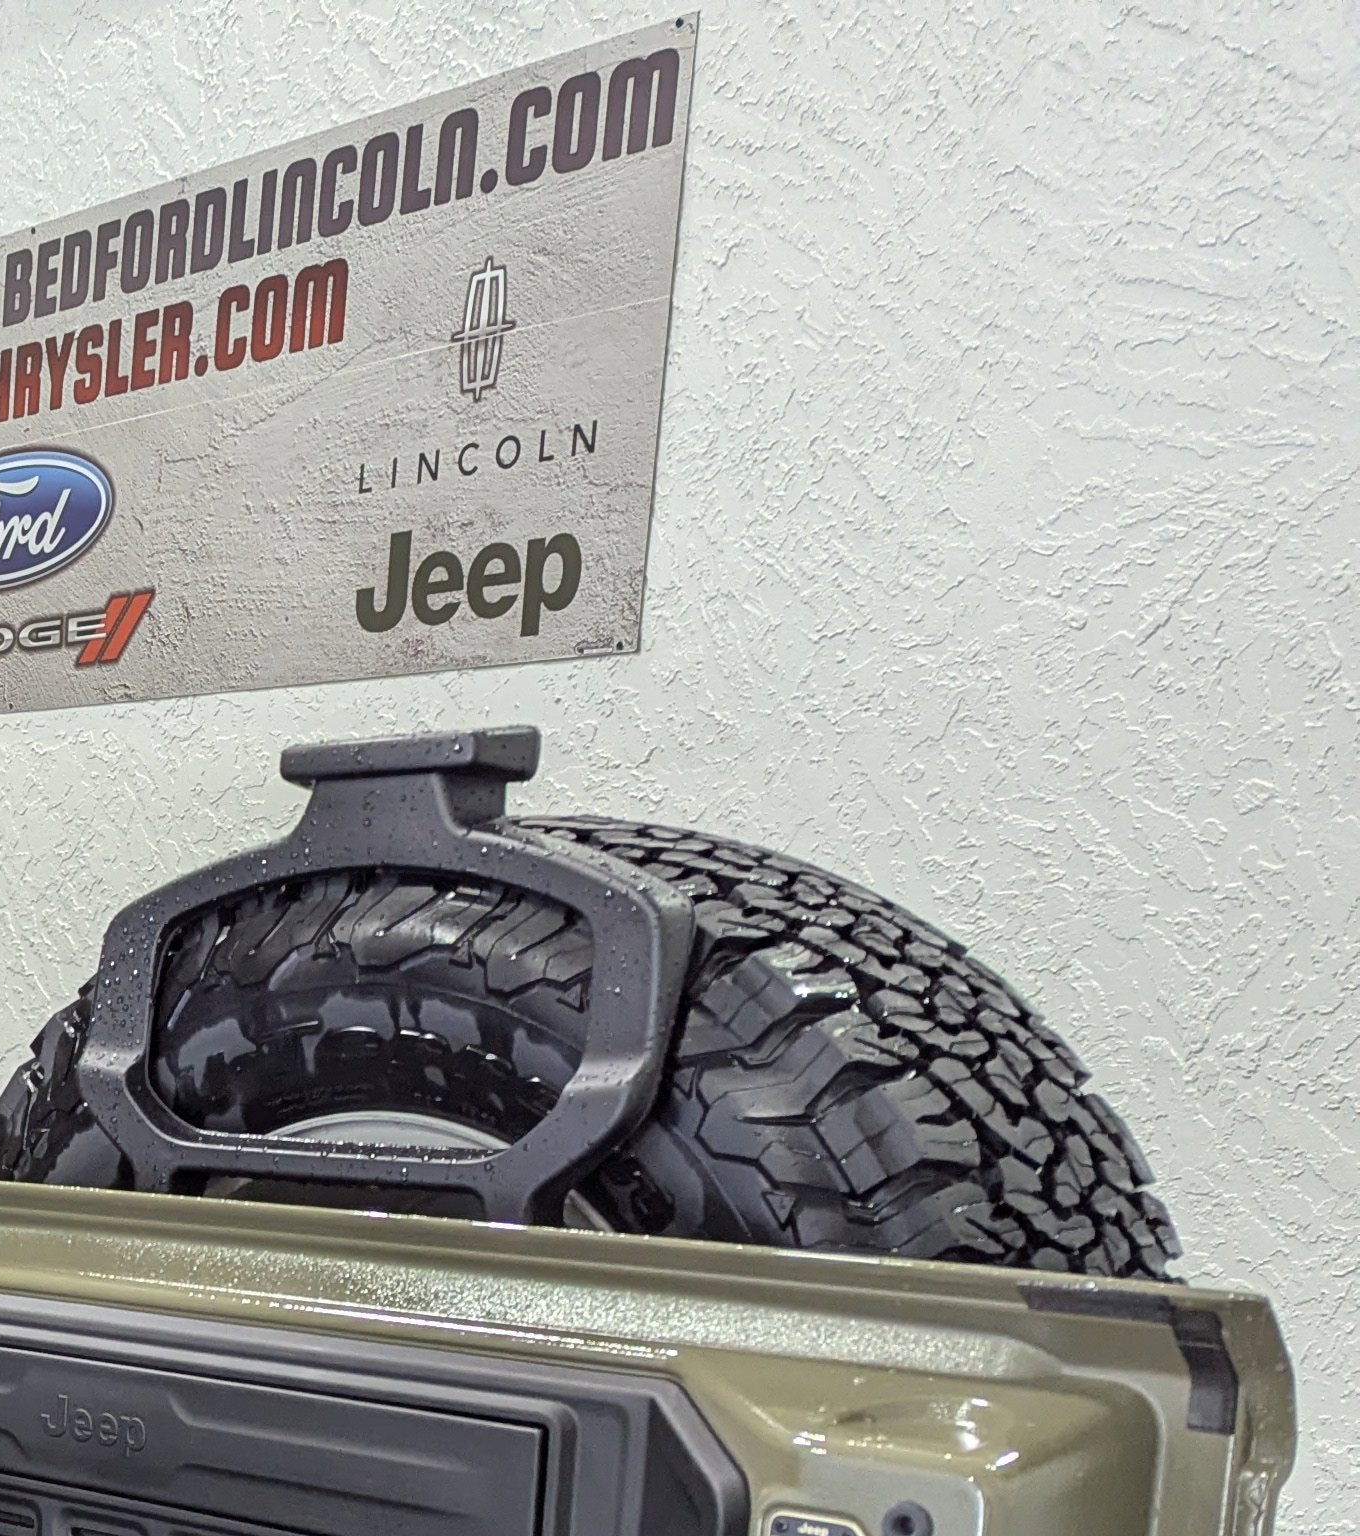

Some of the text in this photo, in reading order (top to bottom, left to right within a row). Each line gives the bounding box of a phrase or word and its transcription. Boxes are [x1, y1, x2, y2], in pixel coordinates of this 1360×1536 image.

[3, 48, 680, 328] BEDFORDLINCOLN.COM
[358, 419, 598, 494] LINCOLN
[355, 529, 582, 637] Jeep
[40, 1393, 147, 1457] Jeep
